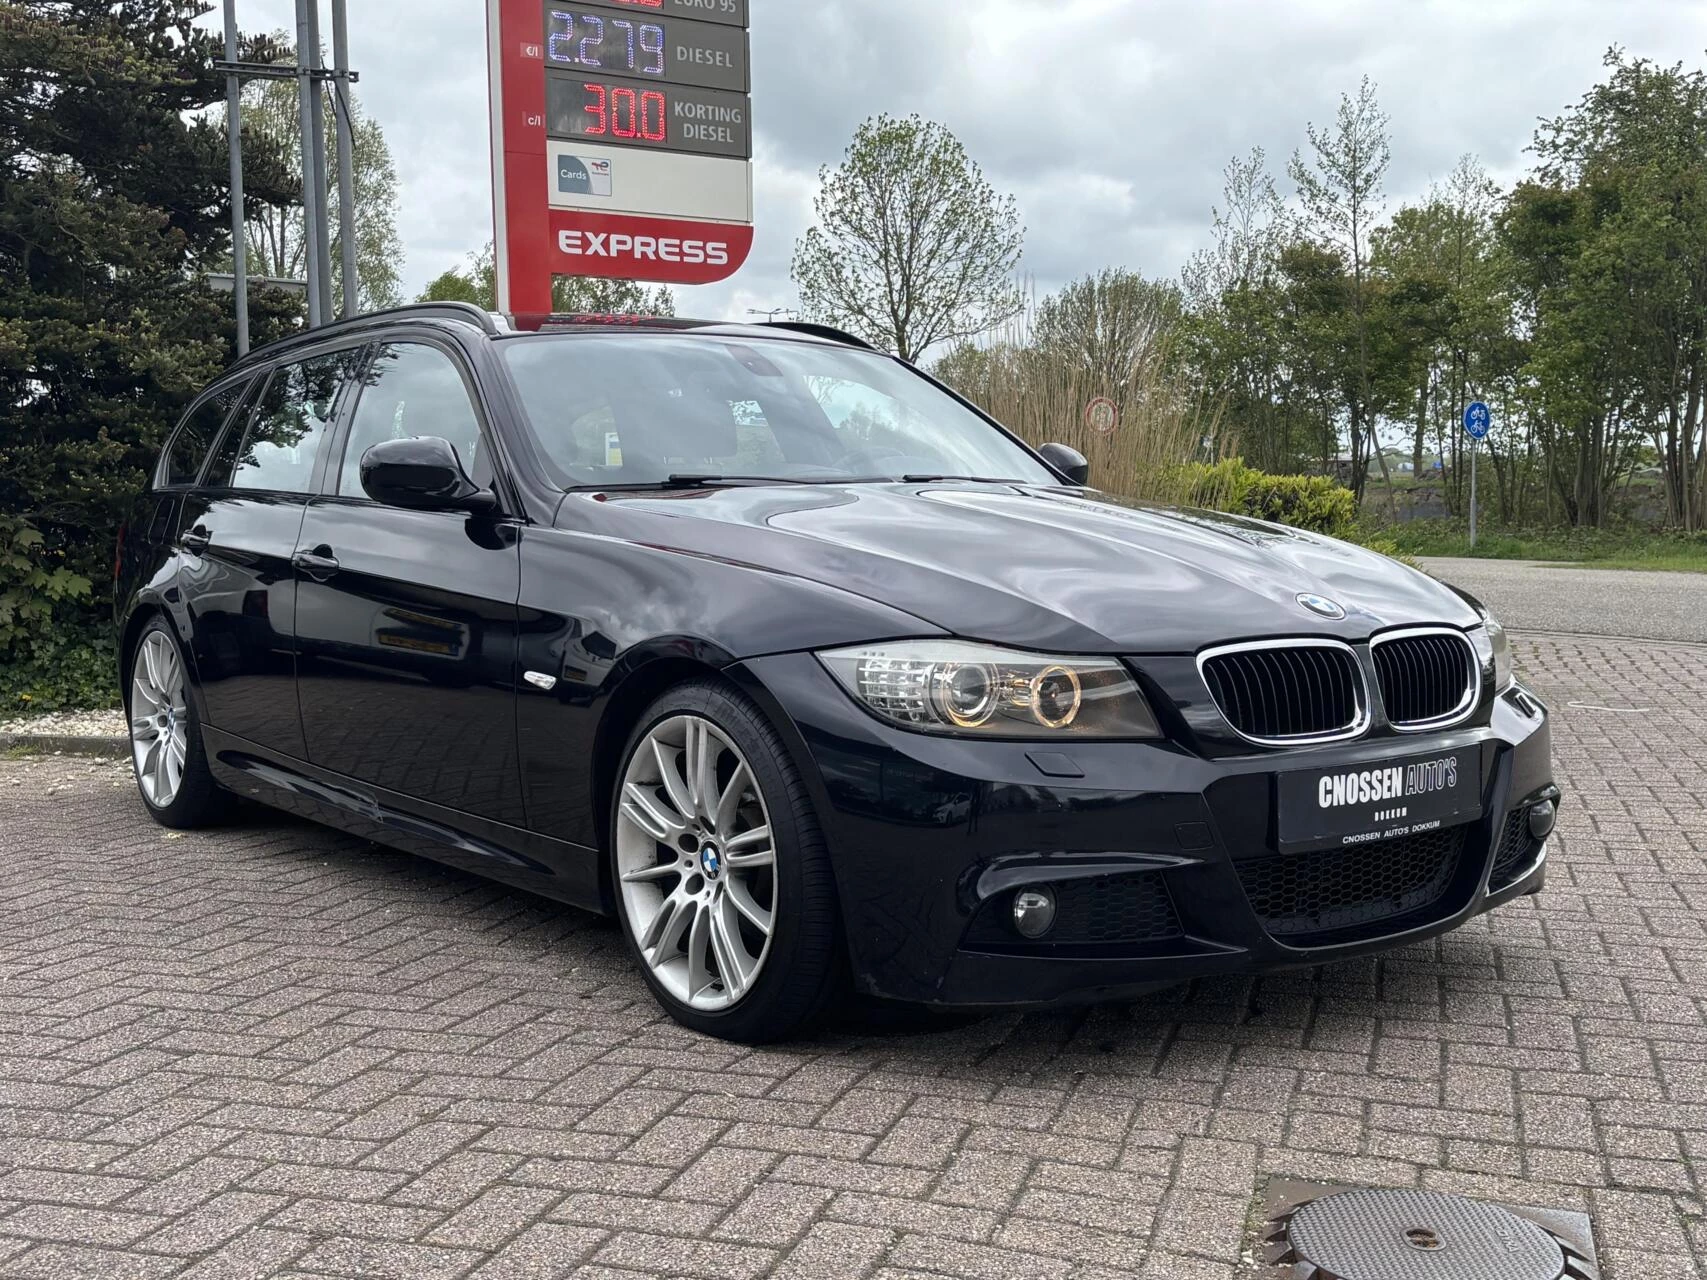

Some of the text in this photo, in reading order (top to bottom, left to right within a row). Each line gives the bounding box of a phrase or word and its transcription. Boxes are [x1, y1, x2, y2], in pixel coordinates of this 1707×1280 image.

[549, 10, 663, 74] 2.279
[676, 46, 733, 68] DIESEL
[584, 83, 665, 141] 30.0
[674, 101, 742, 123] KORTING
[683, 123, 735, 143] DIESEL
[560, 169, 587, 180] Cards
[558, 229, 728, 265] EXPRESS
[1318, 756, 1457, 808] CNOSSEN AUTO'S
[1342, 832, 1381, 844] CNOSSEN
[1412, 820, 1441, 832] DOKKUM
